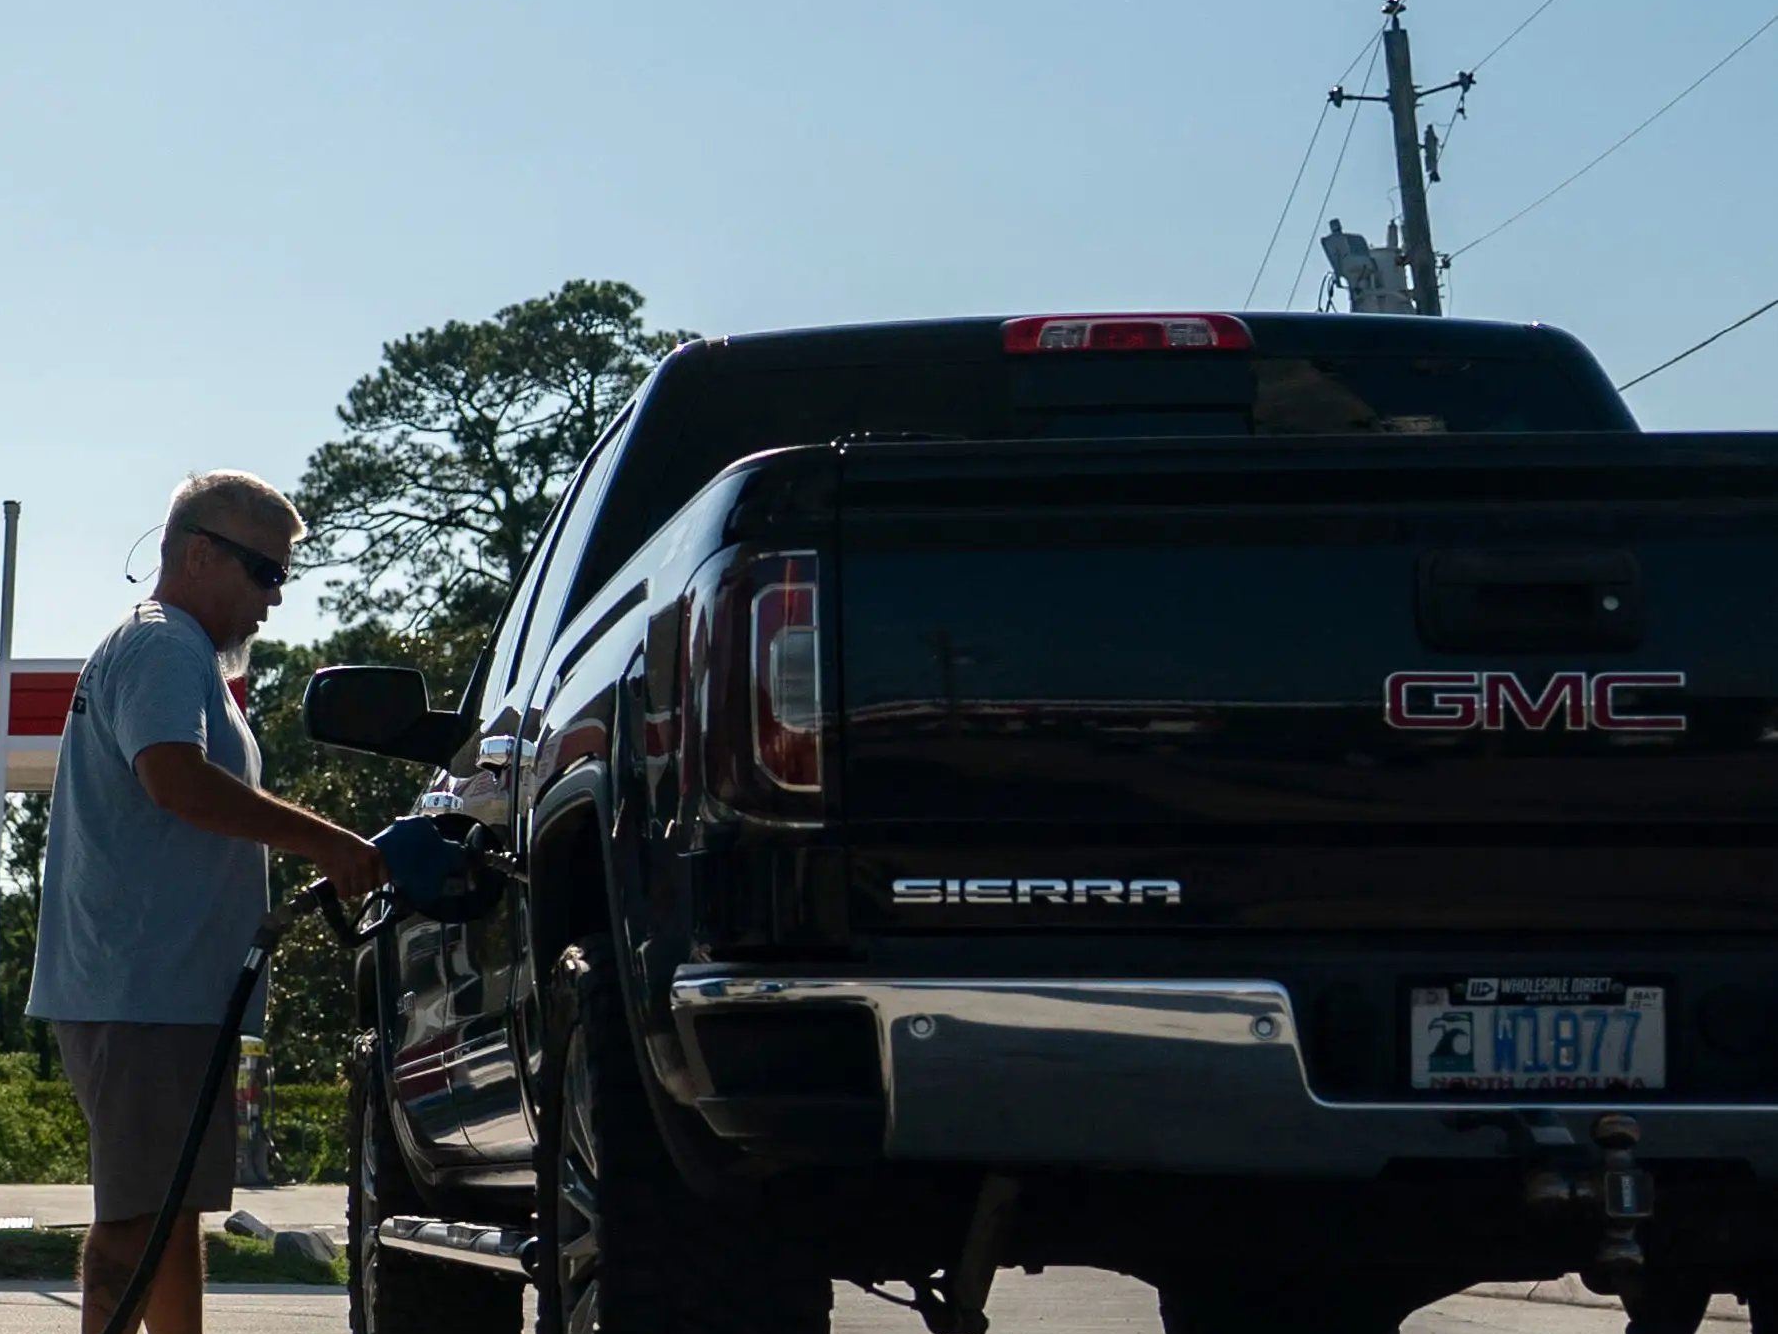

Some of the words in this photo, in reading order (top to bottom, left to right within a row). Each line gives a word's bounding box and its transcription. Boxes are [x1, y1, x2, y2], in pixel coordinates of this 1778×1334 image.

[1384, 671, 1686, 730] GMC
[892, 879, 1181, 903] SIERRA
[1501, 977, 1570, 993] WHOLESALE
[1571, 977, 1613, 993] DIRECT
[1493, 1007, 1642, 1073] W1877
[1524, 1076, 1646, 1089] CAROLINA
